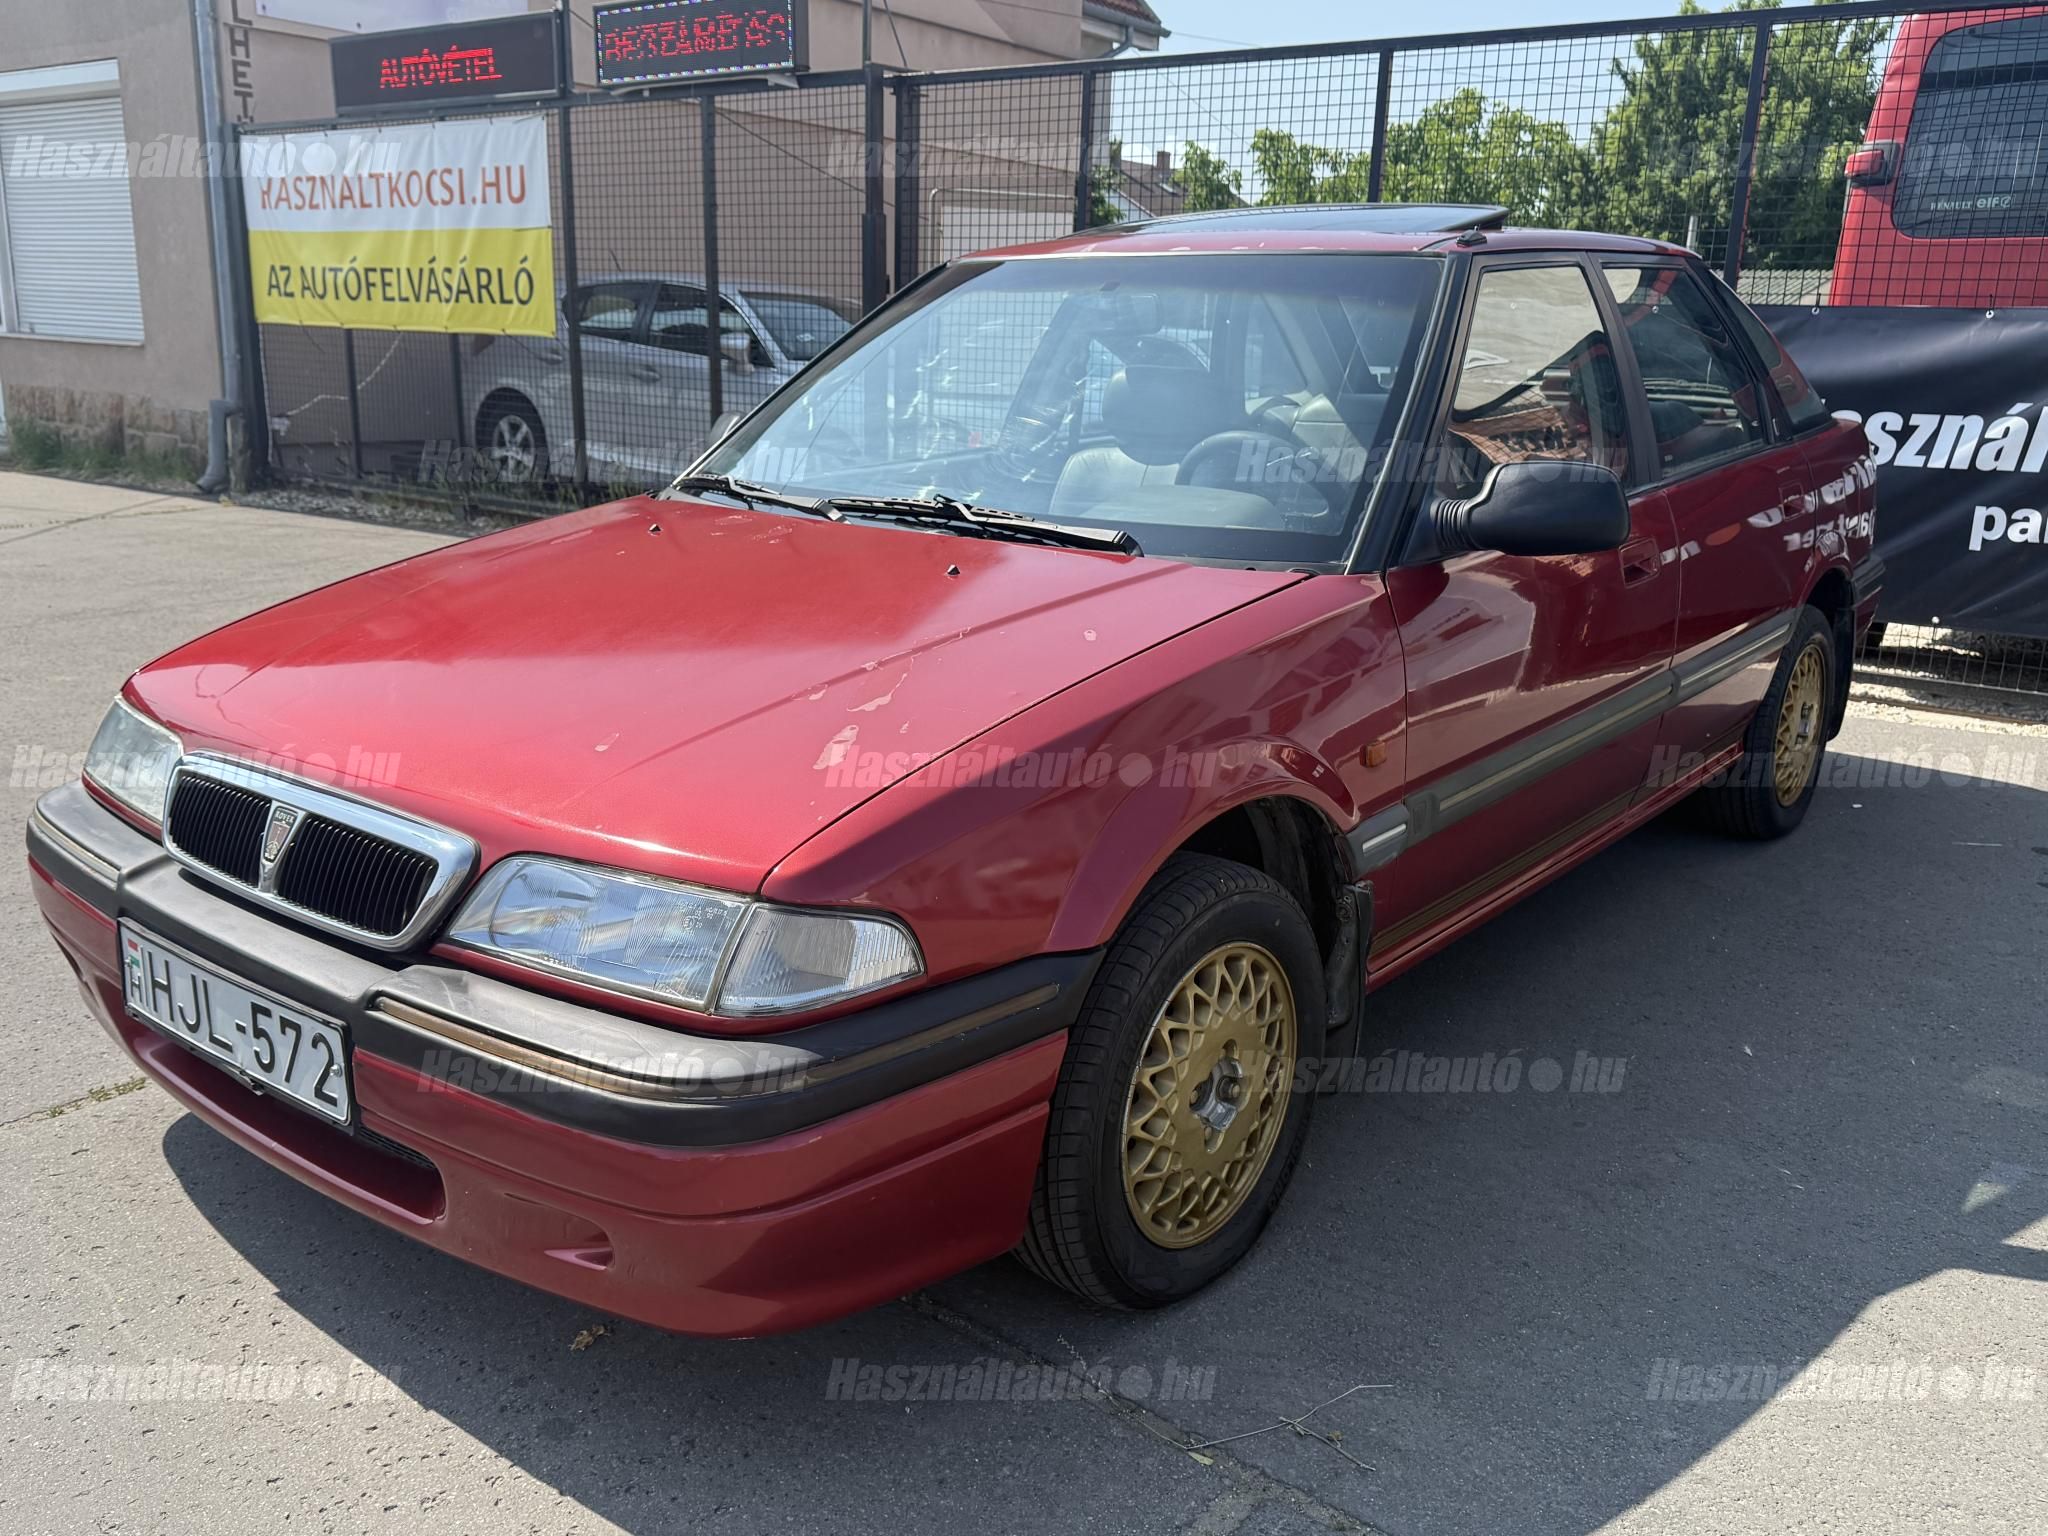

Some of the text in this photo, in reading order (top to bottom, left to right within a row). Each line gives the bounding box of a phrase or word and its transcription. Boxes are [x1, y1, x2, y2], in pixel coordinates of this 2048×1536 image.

[267, 255, 534, 306] AZ AUTÓFELVÁSÁRLÓ
[1822, 399, 2048, 473] sznál
[1968, 504, 2048, 551] pa
[147, 950, 338, 1108] HJL-572
